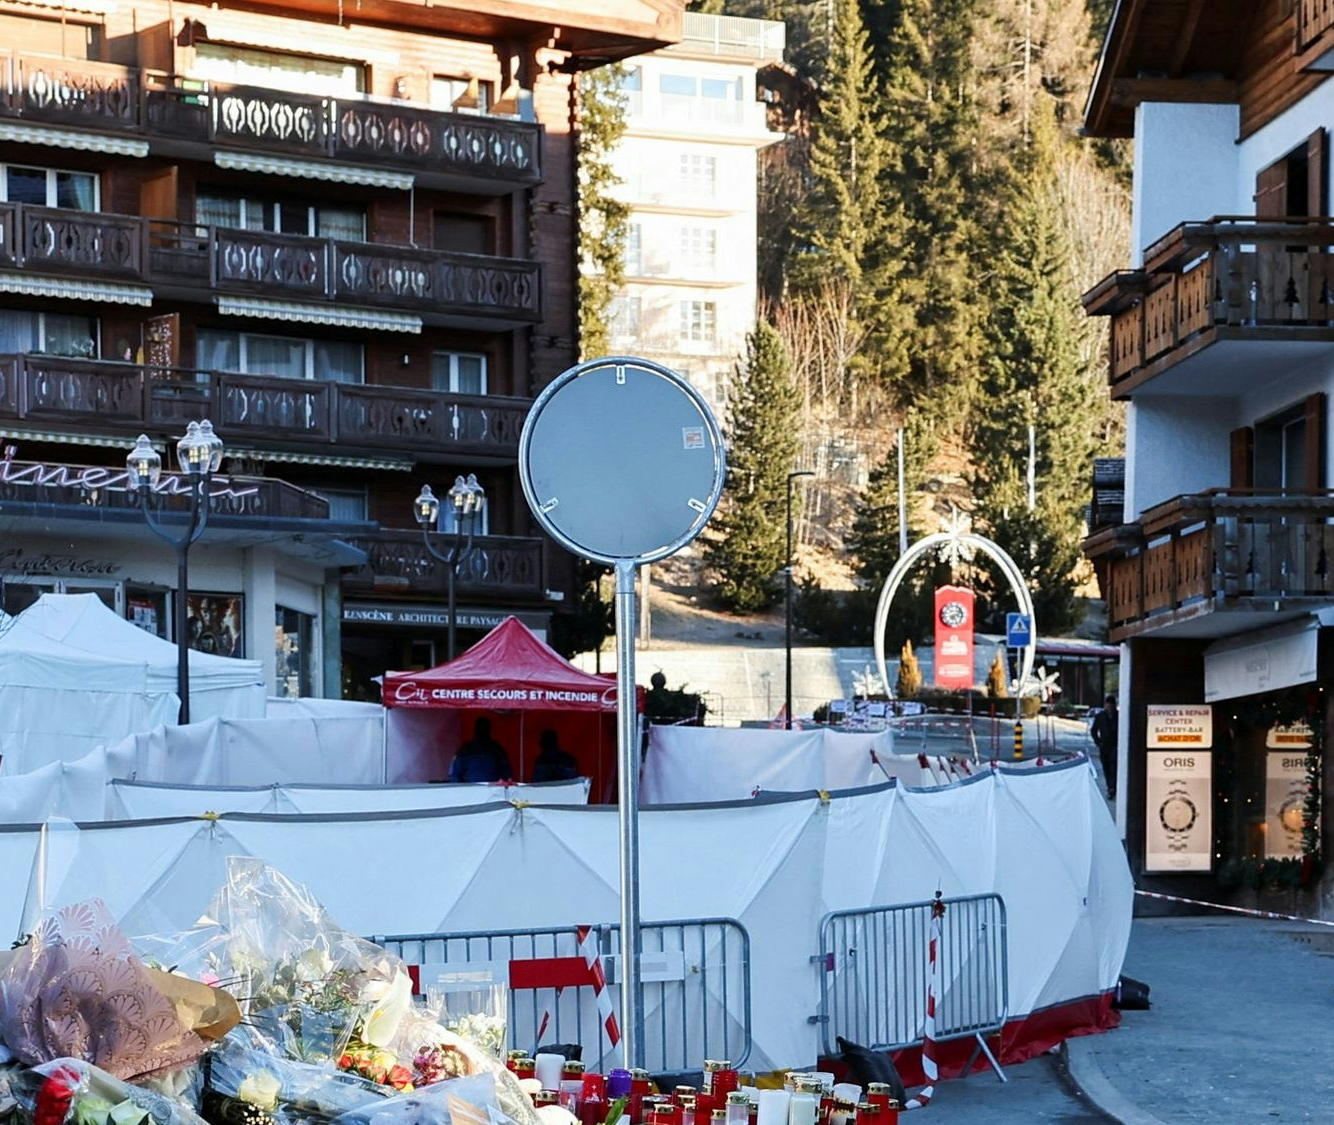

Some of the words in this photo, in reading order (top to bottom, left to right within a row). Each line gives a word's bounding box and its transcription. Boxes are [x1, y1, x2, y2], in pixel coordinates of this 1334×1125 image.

[398, 613, 468, 625] ARCHITECTRE
[432, 688, 475, 700] CENTRE
[477, 689, 527, 700] SECOURS
[529, 690, 543, 700] ET
[545, 691, 598, 702] INCENDIE
[1148, 709, 1178, 717] SERVICE
[1163, 757, 1195, 768] ORIS
